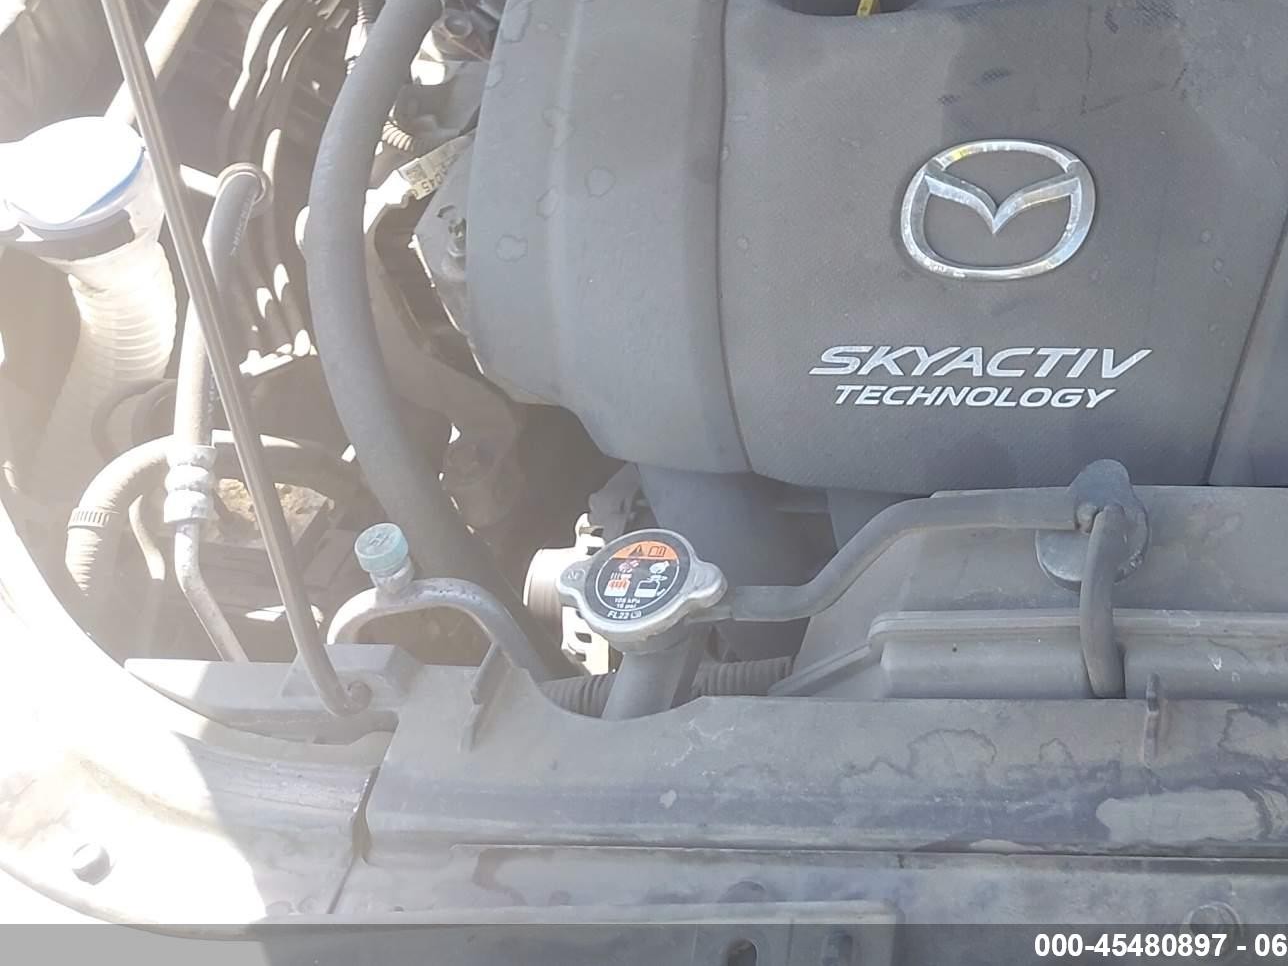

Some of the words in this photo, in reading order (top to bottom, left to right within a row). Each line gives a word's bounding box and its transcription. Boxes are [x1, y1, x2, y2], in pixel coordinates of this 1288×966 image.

[809, 346, 1152, 378] SKYACTIV
[834, 384, 1117, 409] TECHNOLOGY
[607, 610, 630, 620] FL22
